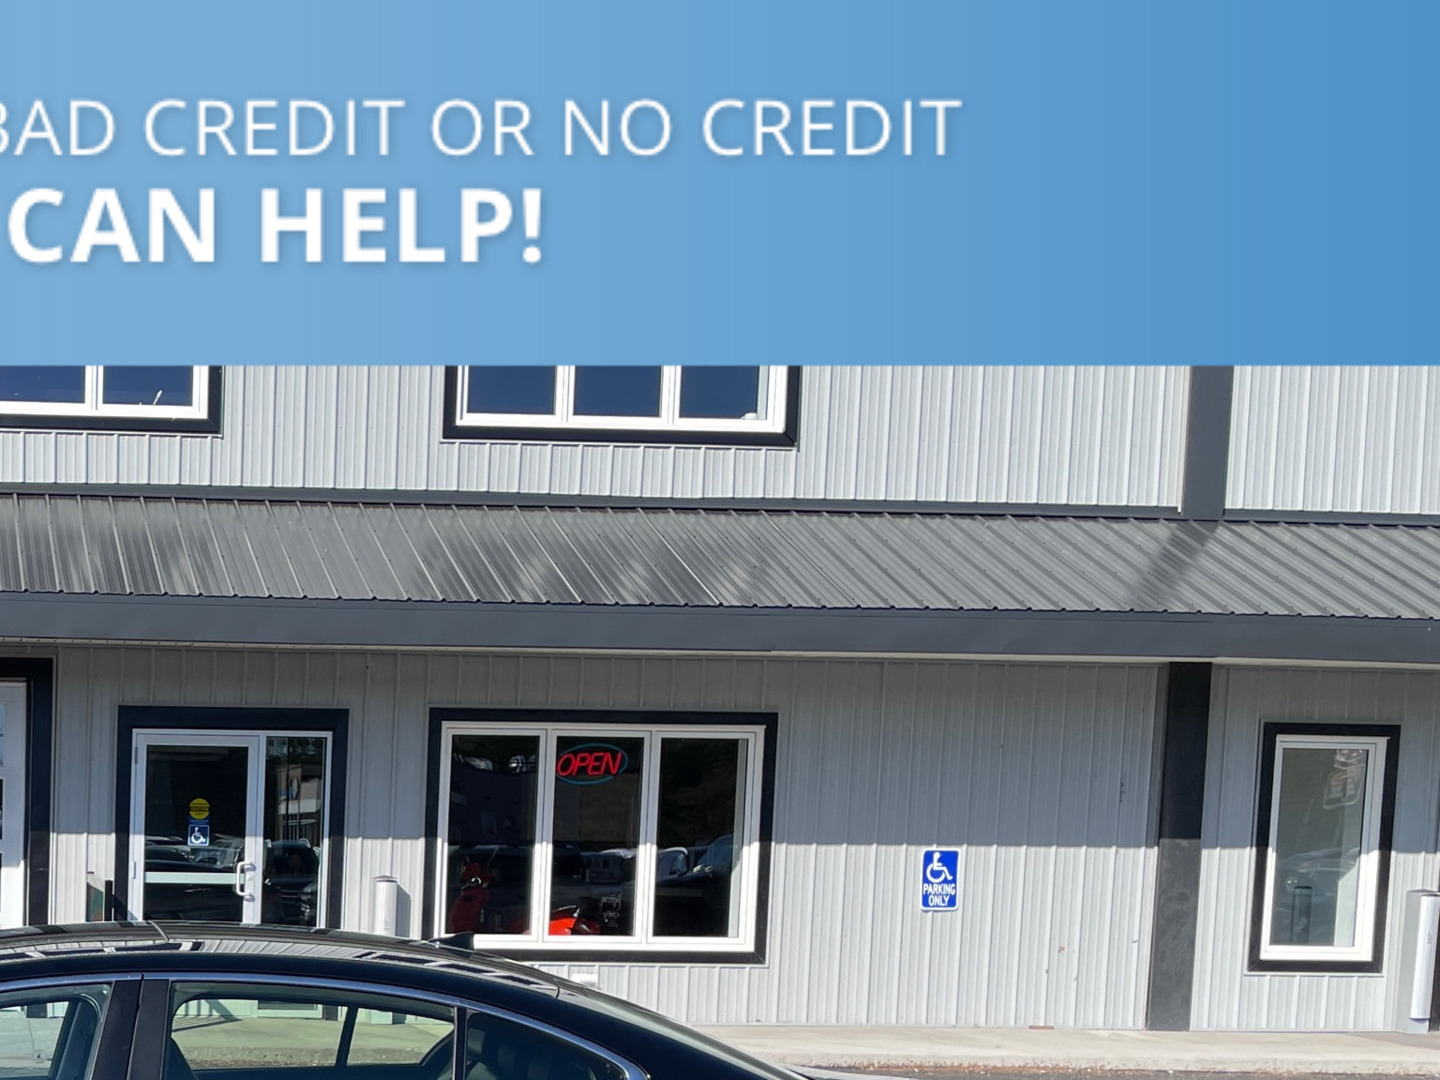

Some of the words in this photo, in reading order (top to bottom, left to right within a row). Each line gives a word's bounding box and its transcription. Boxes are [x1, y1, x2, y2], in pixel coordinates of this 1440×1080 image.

[556, 751, 622, 777] OPEN
[923, 883, 956, 895] PARKING
[928, 895, 950, 907] ONLY
